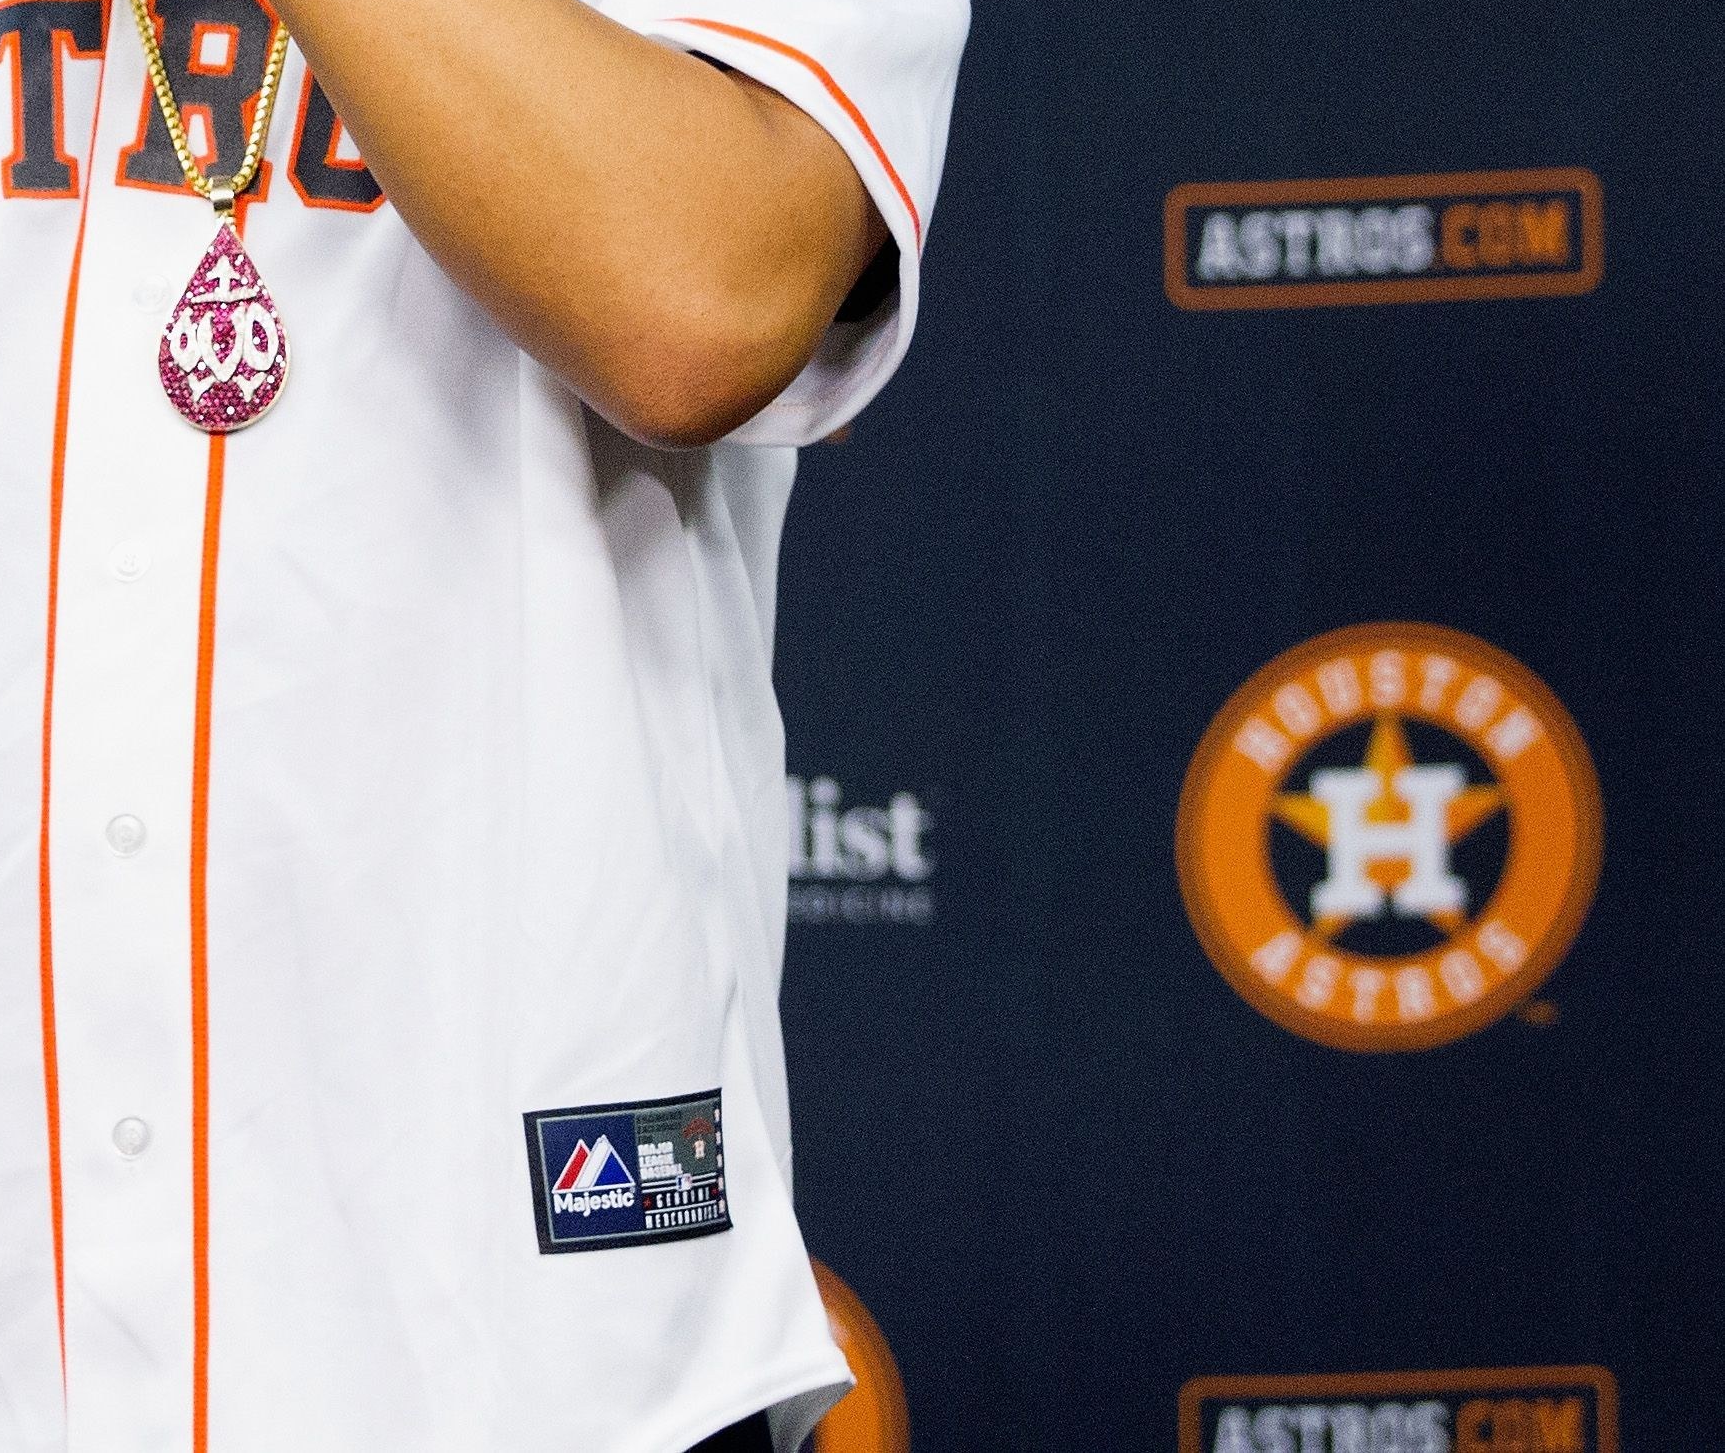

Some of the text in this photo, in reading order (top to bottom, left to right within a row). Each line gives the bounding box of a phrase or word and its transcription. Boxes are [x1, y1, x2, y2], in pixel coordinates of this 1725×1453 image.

[1232, 648, 1547, 772] HOUSTON
[1307, 763, 1470, 917] H
[1248, 917, 1529, 1025] ASTROS
[552, 1189, 636, 1217] Majestic
